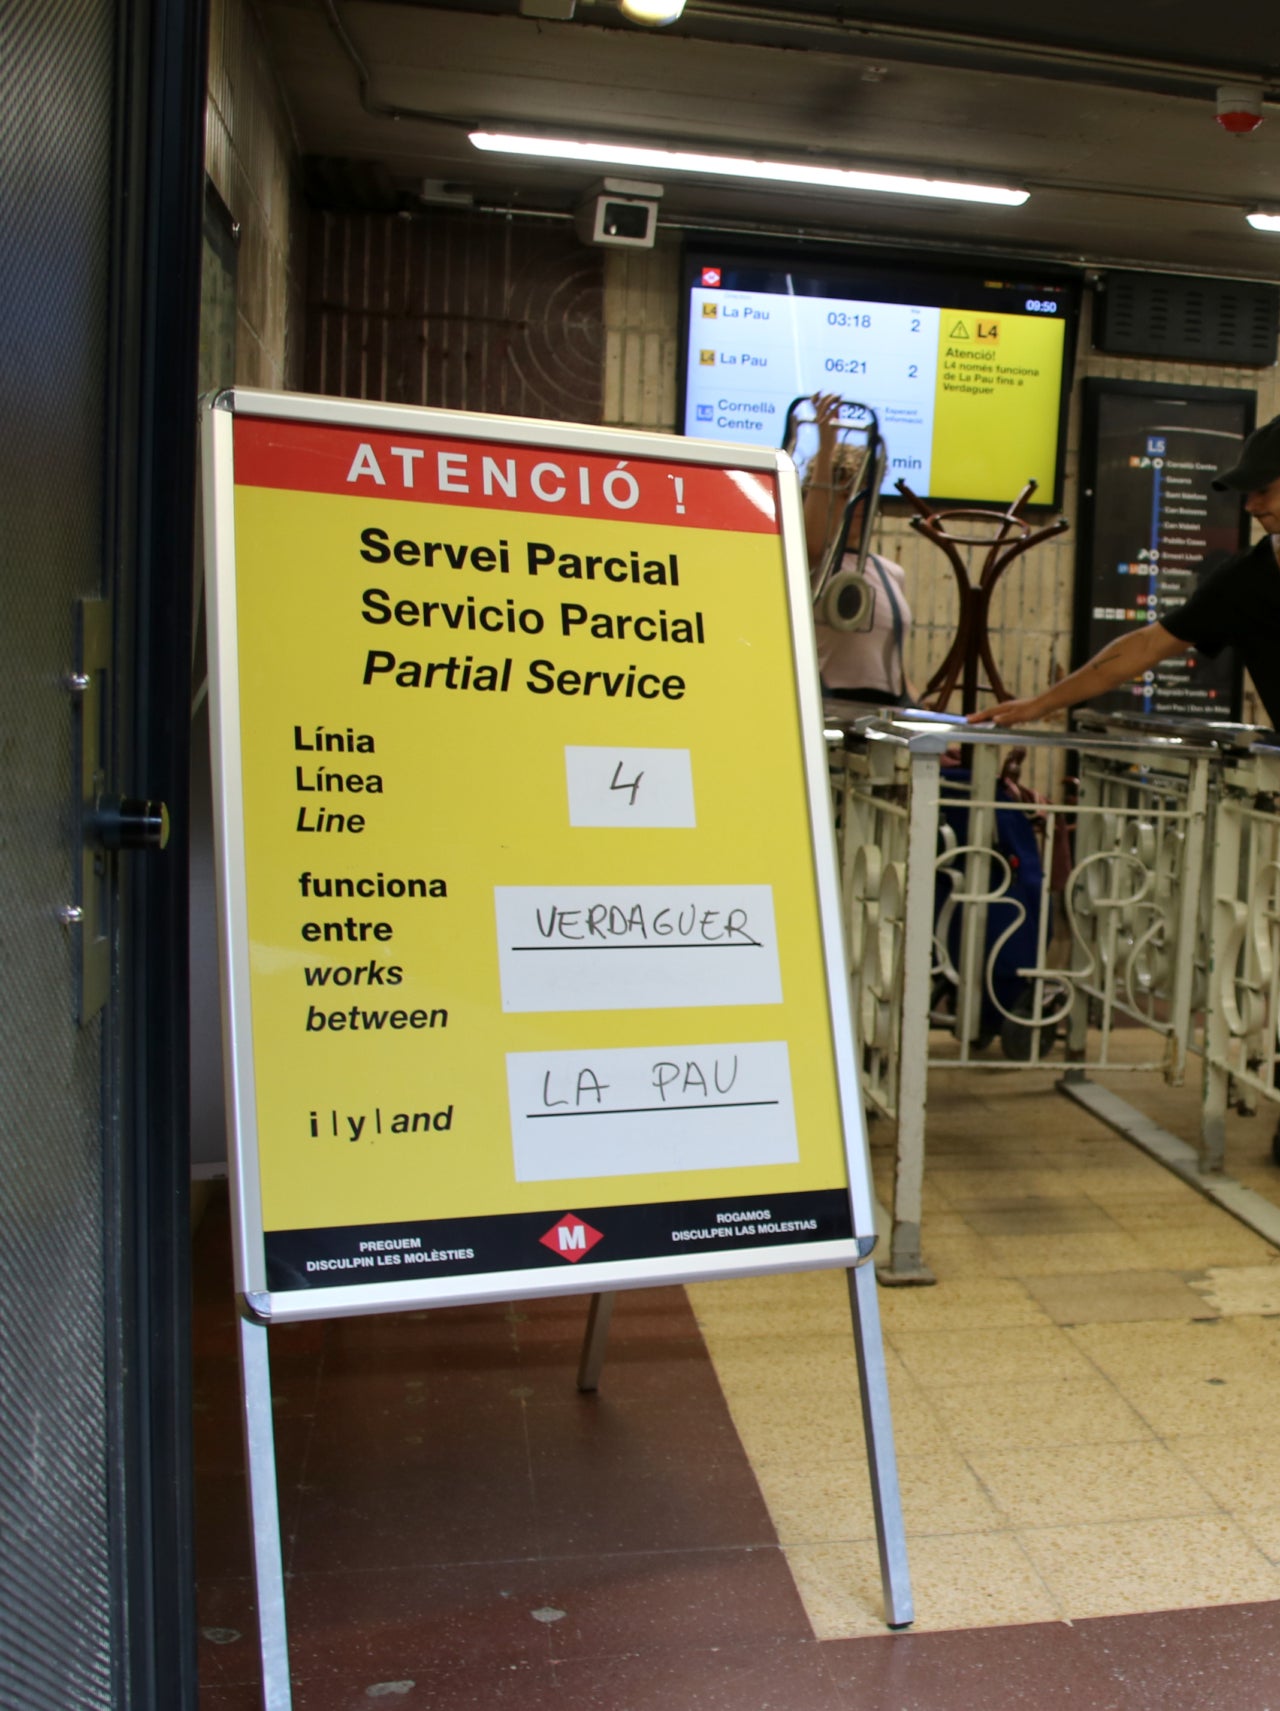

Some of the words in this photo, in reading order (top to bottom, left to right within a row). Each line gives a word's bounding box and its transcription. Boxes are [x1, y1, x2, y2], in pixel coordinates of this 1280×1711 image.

[1025, 299, 1057, 313] 09:50
[722, 306, 739, 318] La
[743, 307, 770, 320] Pau
[827, 312, 871, 328] 03:18
[911, 319, 921, 333] 2
[978, 323, 998, 339] L4
[720, 353, 737, 365] La
[741, 353, 768, 367] Pau
[825, 358, 867, 374] 06:21
[908, 364, 918, 378] 2
[945, 347, 996, 361] Atenció!
[944, 361, 956, 370] L4
[996, 365, 1040, 377] funciona
[944, 372, 956, 381] de
[959, 373, 971, 382] La
[974, 374, 994, 384] Pau
[943, 383, 994, 395] Verdaguer
[718, 399, 775, 414] Cornellà
[717, 417, 763, 430] Centre
[1147, 440, 1165, 453] L5
[892, 455, 922, 470] min
[346, 441, 640, 510] ATENCIÓ
[359, 526, 511, 575] Servei
[526, 541, 681, 587] Parcial
[361, 587, 545, 635] Servicio
[559, 602, 706, 645] Parcial
[361, 649, 513, 693] Partial
[526, 658, 688, 701] Service
[293, 725, 377, 755] Línia
[296, 765, 385, 795] Línea
[609, 760, 645, 806] 4
[296, 806, 367, 834] Line
[298, 871, 449, 898] funciona
[301, 917, 394, 942] entre
[535, 902, 763, 947] VERDAGUER
[303, 959, 404, 987] works
[305, 1005, 450, 1032] between
[542, 1066, 610, 1108] LA
[651, 1055, 740, 1102] PAU
[389, 1105, 455, 1135] and
[716, 1209, 771, 1223] ROGAMOS
[557, 1225, 587, 1251] M
[671, 1226, 733, 1242] DISCULPEN
[735, 1225, 756, 1237] LAS
[757, 1219, 818, 1234] MOLESTIAS
[359, 1237, 422, 1252] PREGUEM
[306, 1257, 374, 1272] DISCULPIN
[377, 1255, 401, 1266] LES
[404, 1248, 475, 1264] MOLÈSTIES
